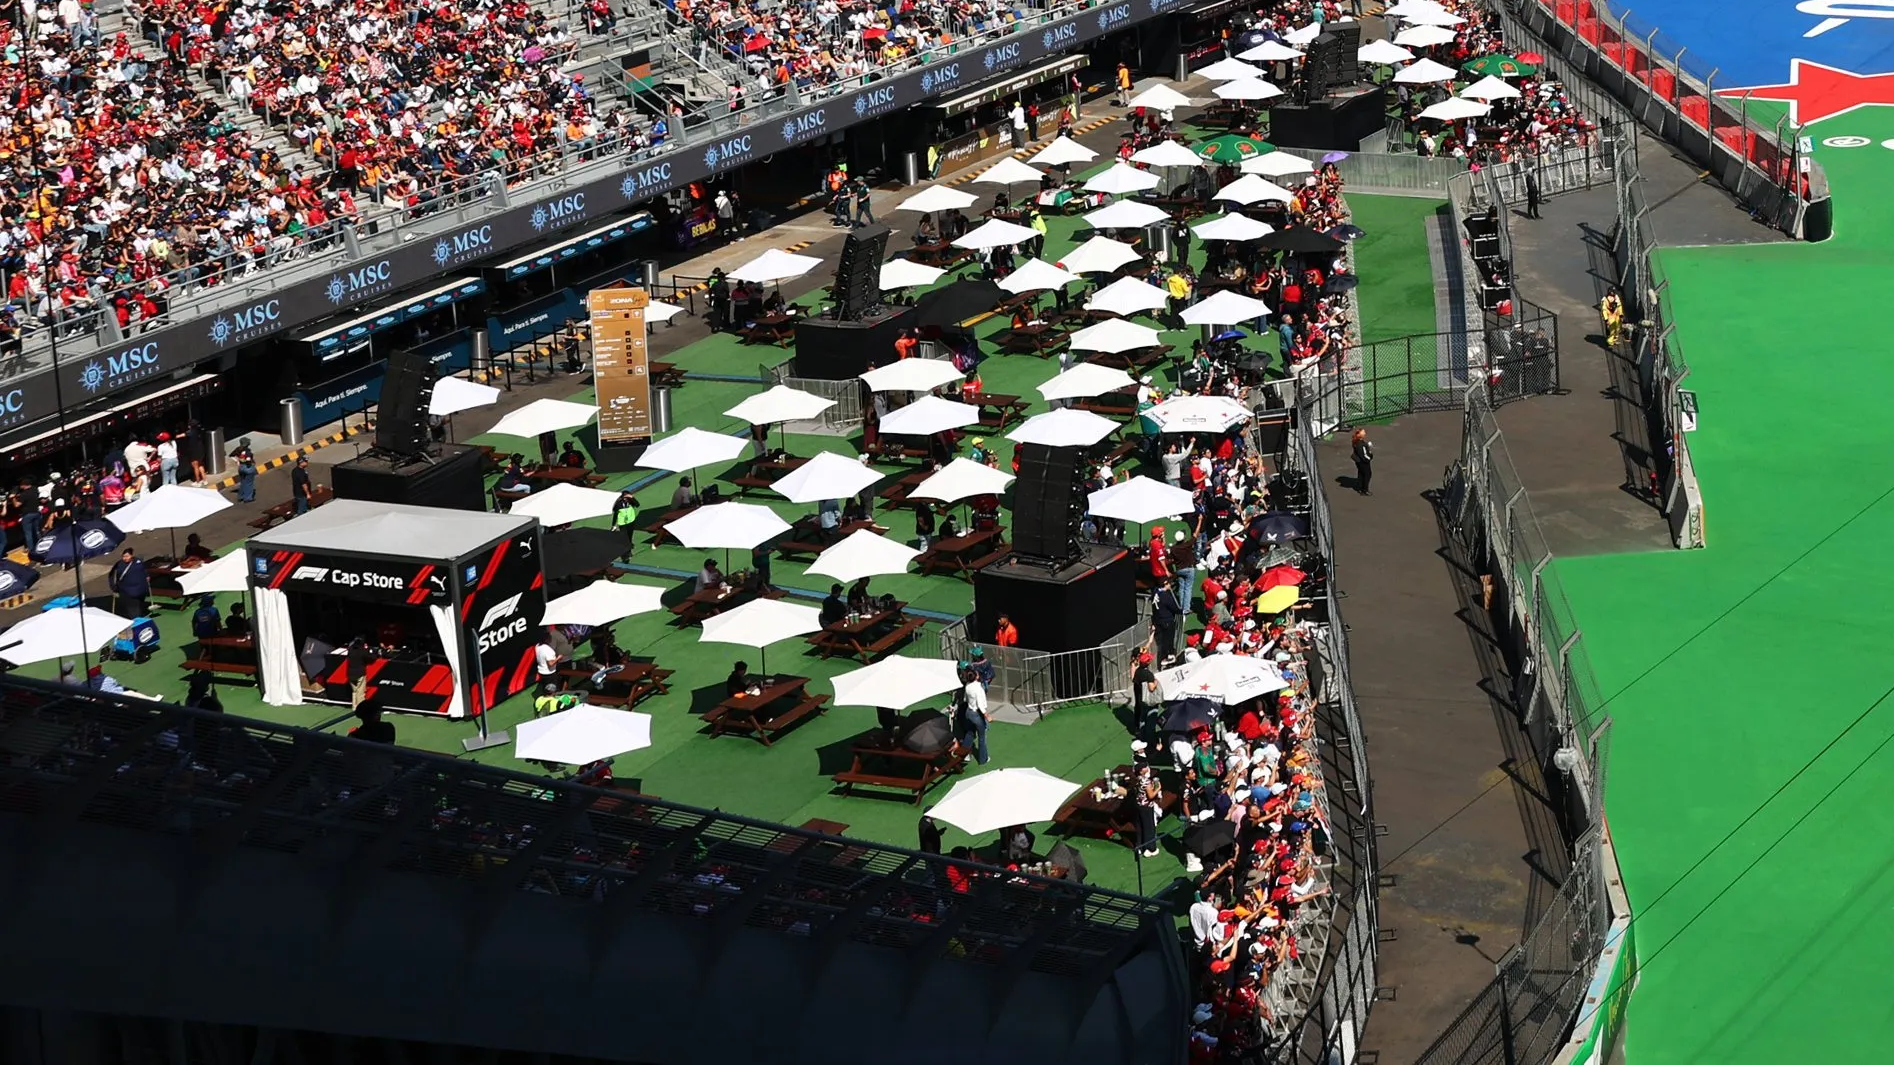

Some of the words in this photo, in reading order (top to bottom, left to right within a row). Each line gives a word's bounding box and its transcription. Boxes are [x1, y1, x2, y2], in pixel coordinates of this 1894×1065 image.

[1109, 4, 1130, 22] MSC
[1054, 22, 1076, 42] MSC
[995, 42, 1020, 63] MSC
[934, 63, 959, 84] MSC
[868, 86, 895, 108] MSC
[868, 102, 896, 116] CRUISES
[797, 109, 826, 133] MSC
[798, 126, 826, 141] CRUISES
[720, 135, 751, 160] MSC
[721, 153, 753, 168] CRUISES
[638, 163, 671, 188] MSC
[639, 181, 673, 198] CRUISES
[549, 193, 585, 220] MSC
[550, 212, 586, 229] CRUISES
[453, 225, 491, 254] MSC
[454, 245, 493, 264] CRUISES
[348, 261, 390, 292] MSC
[349, 281, 392, 301] CRUISES
[234, 300, 280, 332] MSC
[235, 320, 283, 343] CRUISES
[107, 342, 159, 378] MSC
[109, 364, 161, 388] CRUISES
[328, 394, 340, 404] Para
[346, 384, 368, 397] Siempre.
[332, 569, 360, 587] Cap
[362, 571, 404, 590] Store
[478, 616, 528, 655] Store
